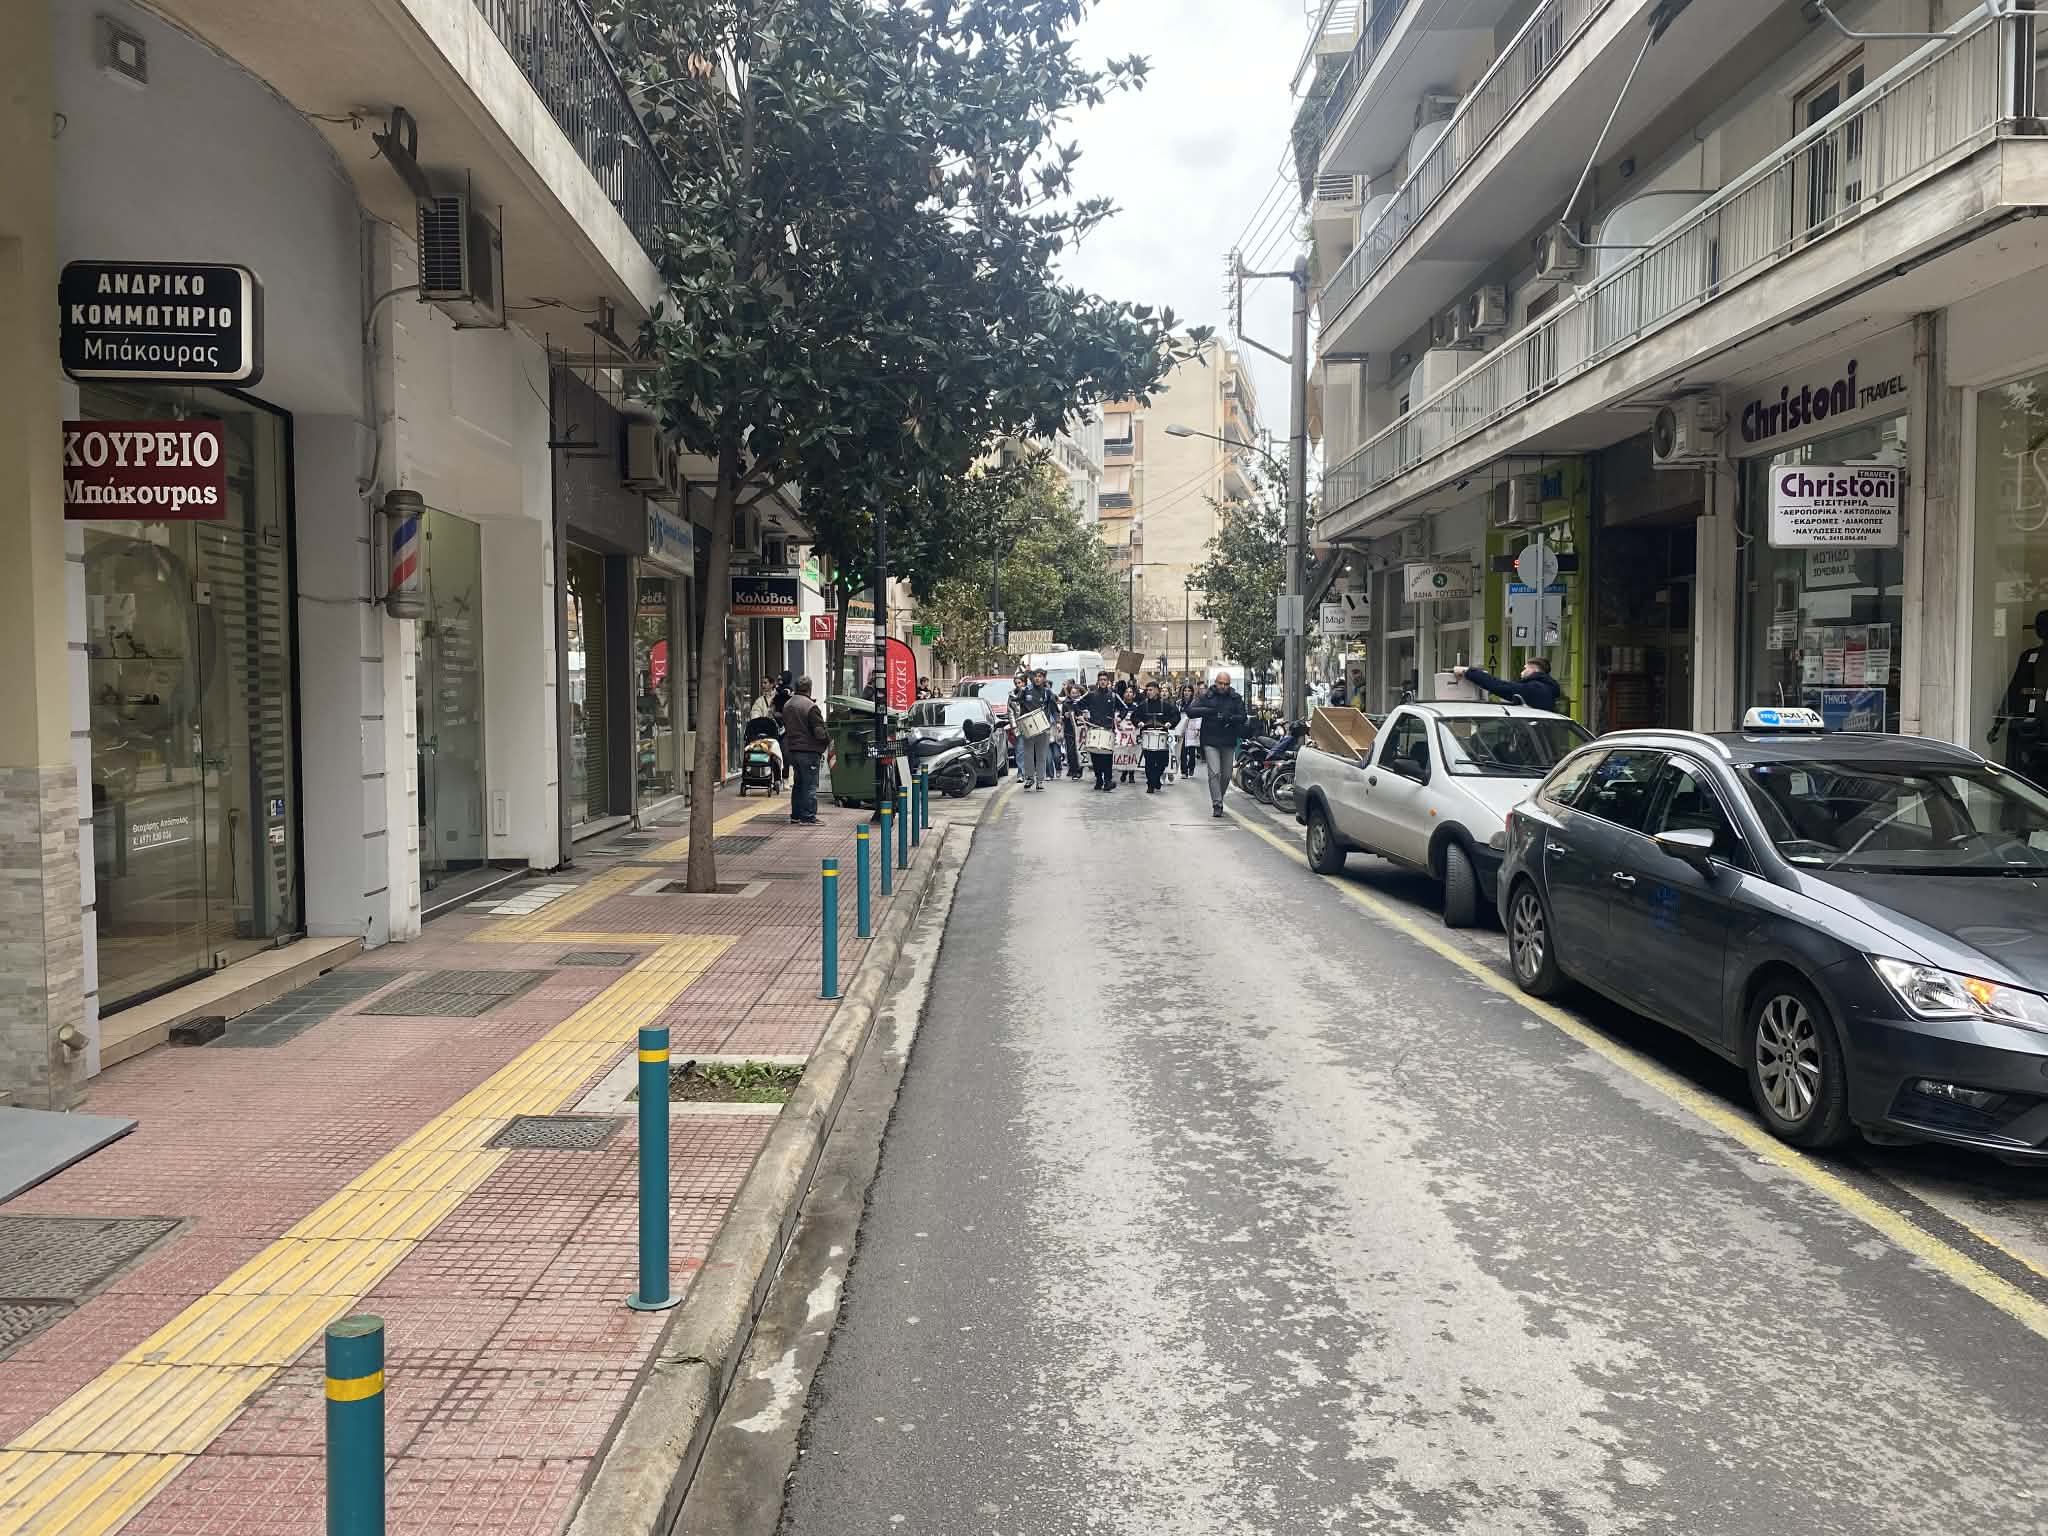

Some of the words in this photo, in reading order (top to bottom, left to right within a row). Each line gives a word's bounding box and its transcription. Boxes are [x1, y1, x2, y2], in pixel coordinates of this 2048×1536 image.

[97, 273, 205, 296] ΑΝΔΡΙΚΟ
[71, 304, 232, 328] ΚΟΜΜΩΤΗΡΙΟ
[84, 337, 219, 367] Μπάκουρας
[1741, 360, 1858, 442] Christoni
[1859, 375, 1907, 408] TRAVEL
[64, 432, 219, 467] ΚΟΥΡΕΙΟ
[1781, 472, 1895, 498] Christoni
